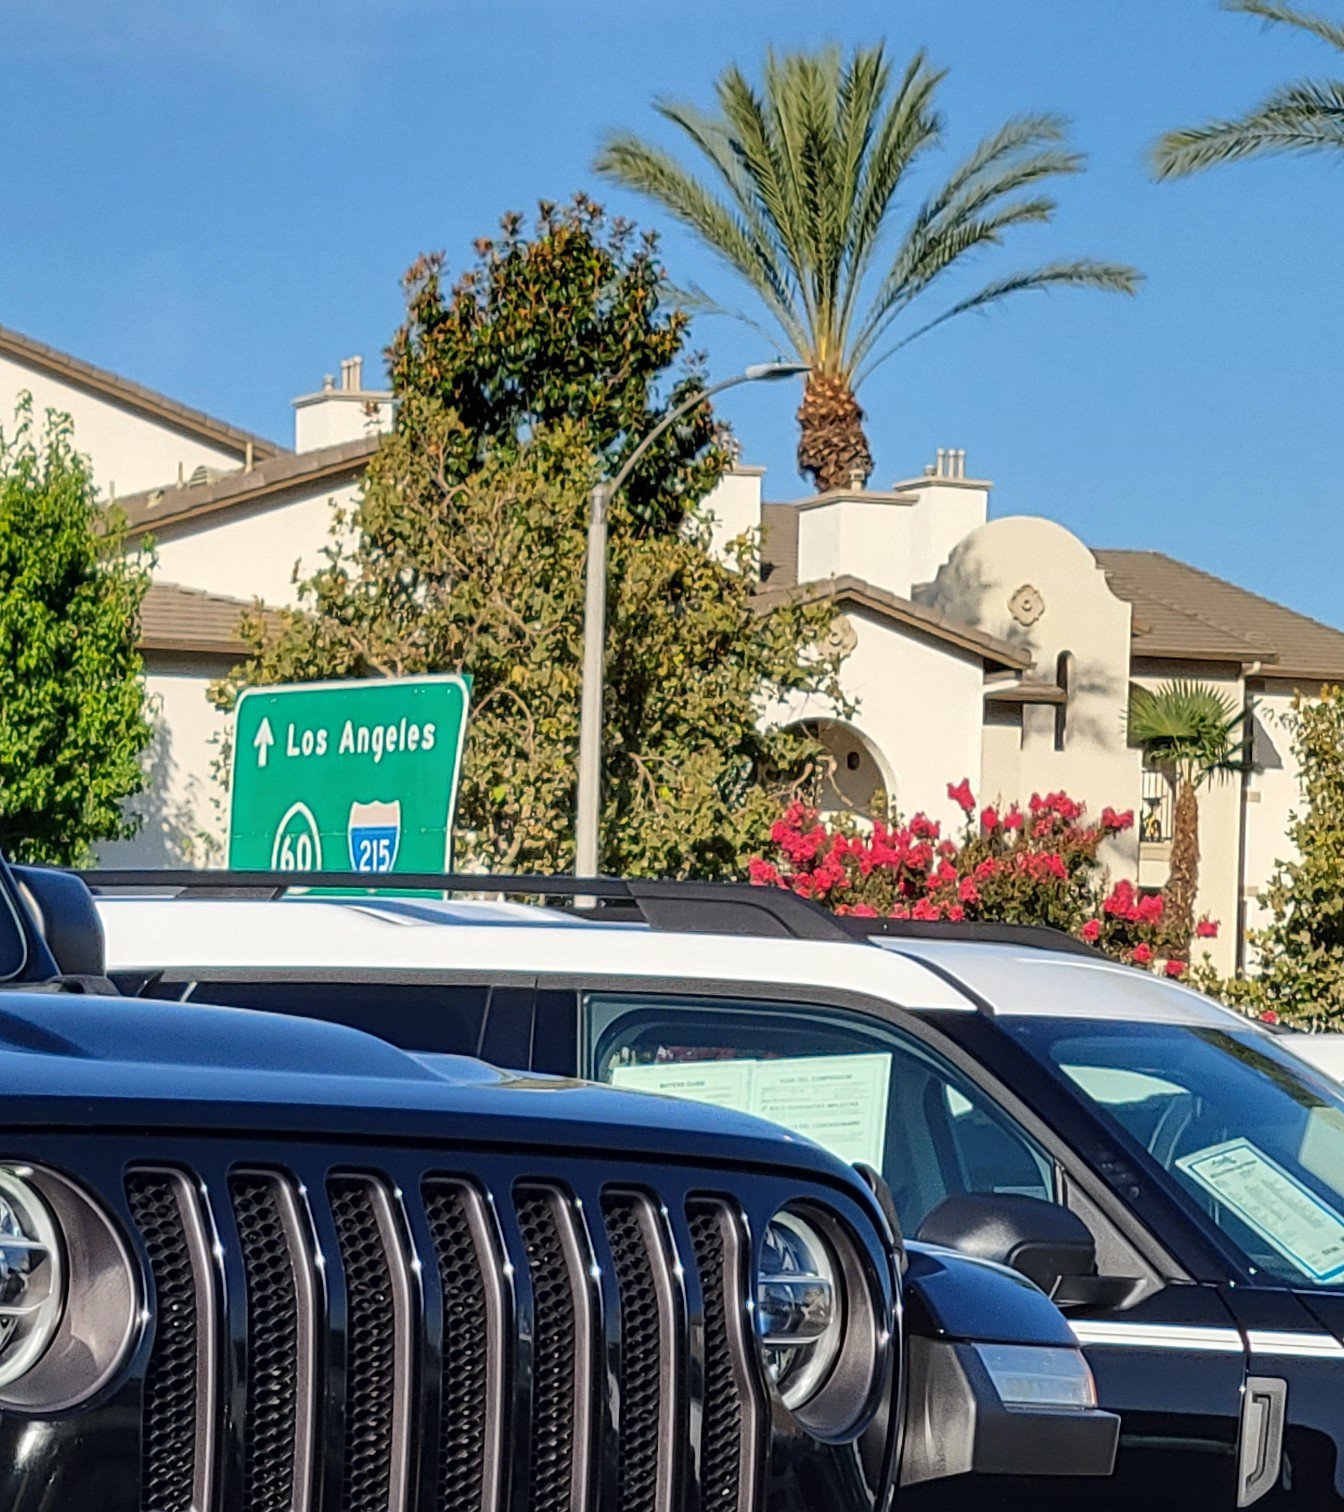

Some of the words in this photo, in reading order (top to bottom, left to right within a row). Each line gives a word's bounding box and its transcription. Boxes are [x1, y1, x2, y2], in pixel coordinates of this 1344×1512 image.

[286, 722, 328, 757] Los
[338, 717, 436, 763] Angeles
[280, 834, 312, 871] 60
[359, 839, 390, 871] 215
